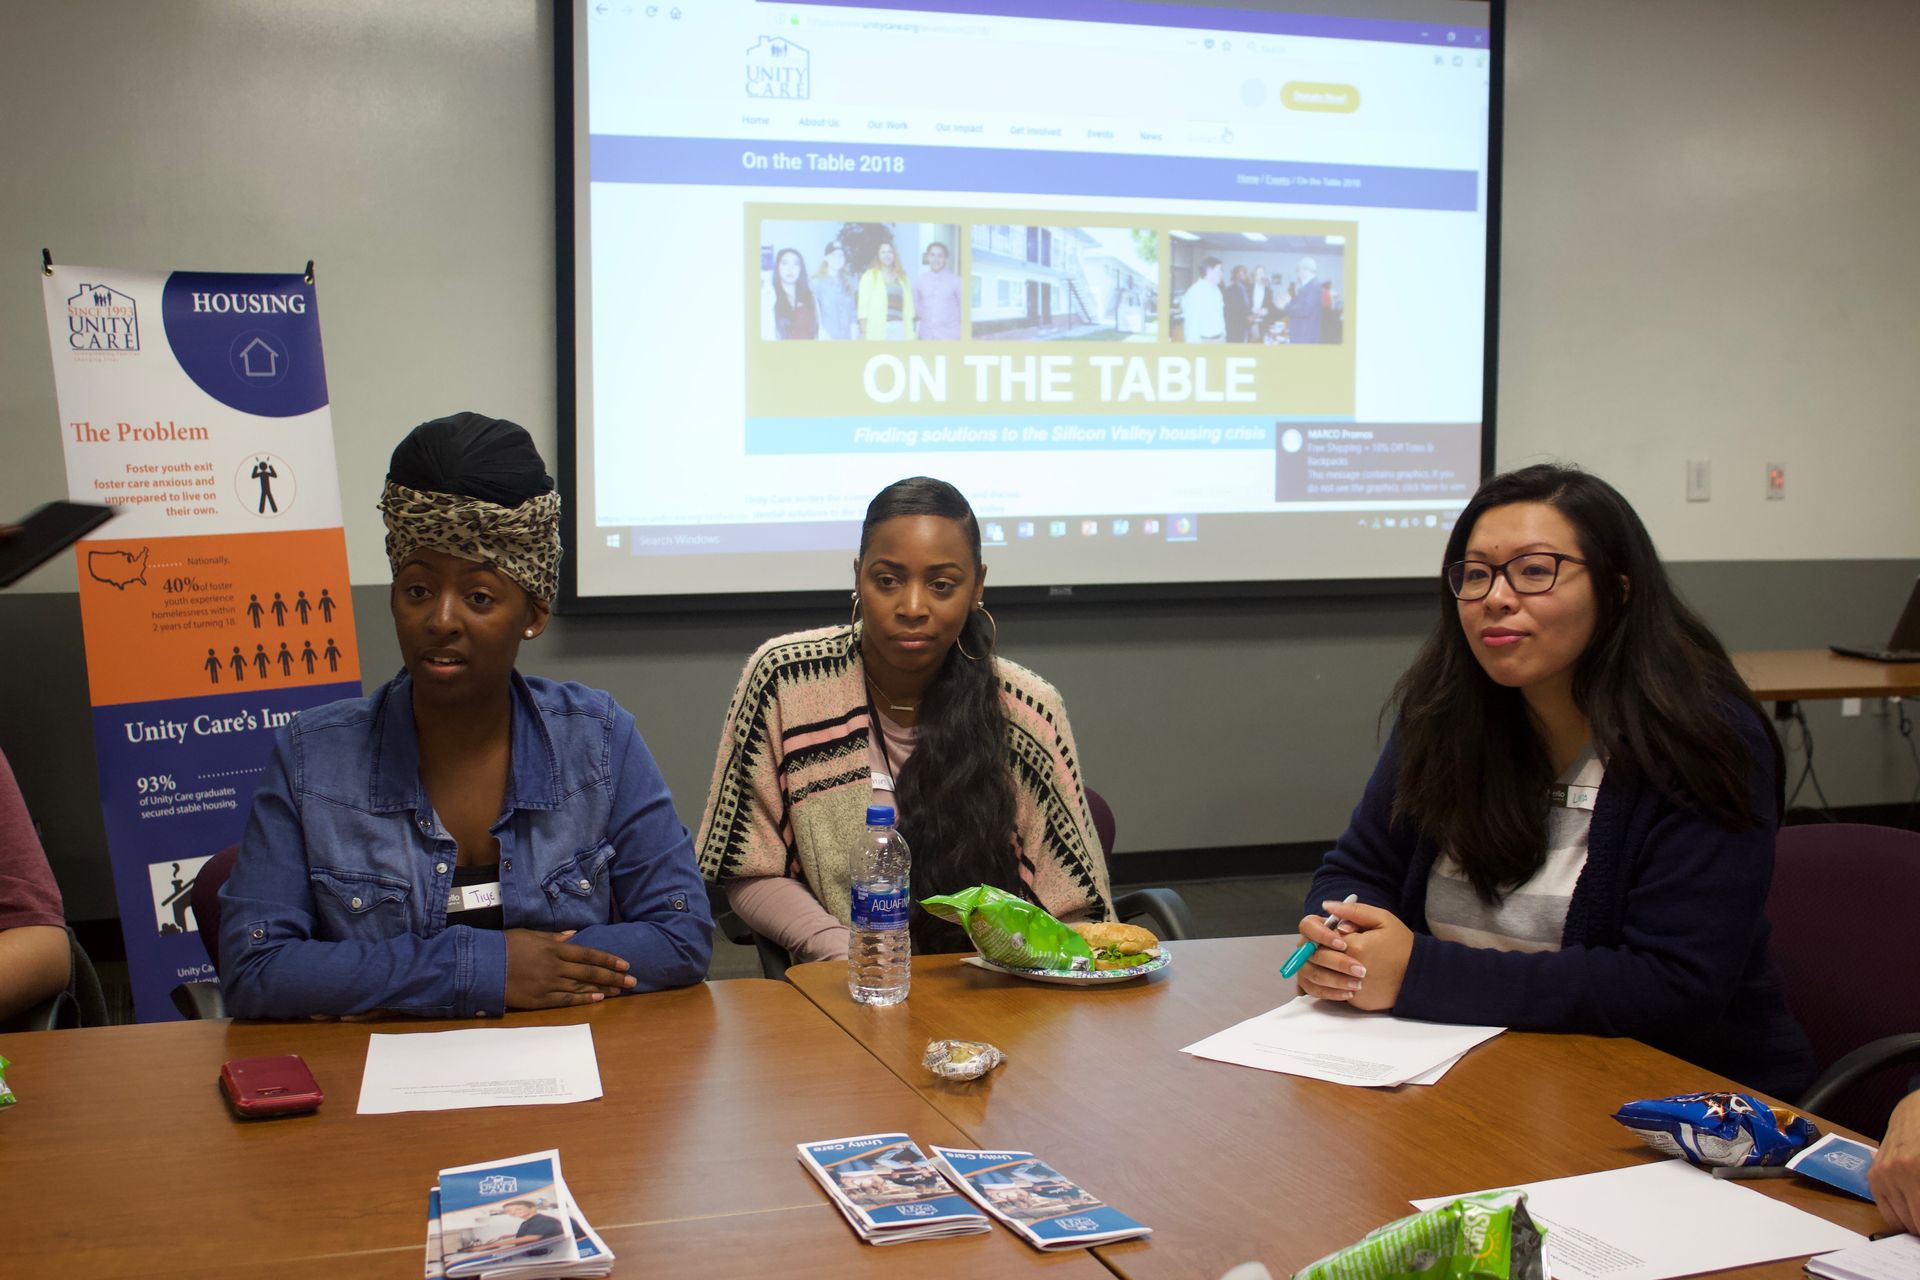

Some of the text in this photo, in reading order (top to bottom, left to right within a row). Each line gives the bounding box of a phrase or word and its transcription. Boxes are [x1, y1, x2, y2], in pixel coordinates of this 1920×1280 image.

[746, 65, 806, 83] UNITY
[745, 82, 806, 98] CARE
[742, 115, 770, 125] Home
[799, 117, 840, 128] About Us
[867, 119, 909, 131] Our Work
[936, 122, 984, 134] Our Impact
[1010, 126, 1062, 136] Get Involved
[1087, 129, 1114, 139] Events
[1140, 131, 1163, 141] News
[742, 151, 904, 173] On the Table 2018
[1237, 174, 1259, 184] Home
[1265, 174, 1290, 186] Events
[1297, 176, 1308, 185] On
[1309, 176, 1320, 186] the
[1322, 177, 1341, 187] Table
[192, 292, 305, 314] HOUSING
[67, 306, 102, 317] SINCE
[69, 316, 133, 334] UNITY
[69, 333, 134, 349] CARE
[863, 353, 1258, 404] ON THE TABLE
[70, 421, 208, 442] The Problem
[853, 425, 1266, 447] Finding solutions to the Silicon Valley housing crisis
[126, 462, 213, 474] Foster youth exit
[95, 477, 216, 490] foster care anxious and
[104, 491, 217, 505] unprepared to live on
[166, 505, 219, 516] their own.
[639, 534, 720, 547] Search Windows
[163, 577, 232, 593] 40% of foster
[164, 594, 234, 607] youth experience
[152, 605, 236, 618] homelessness within
[153, 623, 158, 632] 2
[159, 620, 182, 632] years
[183, 620, 192, 630] of
[193, 617, 224, 629] turning
[124, 719, 189, 745] Unity
[193, 709, 257, 736] Care's
[136, 774, 177, 795] 93%
[139, 787, 236, 807] of Unity Care graduates
[141, 798, 239, 820] secured stable housing.
[177, 966, 200, 978] Unity
[812, 1138, 884, 1153] Unity Care
[945, 1151, 1013, 1161] Unity Care
